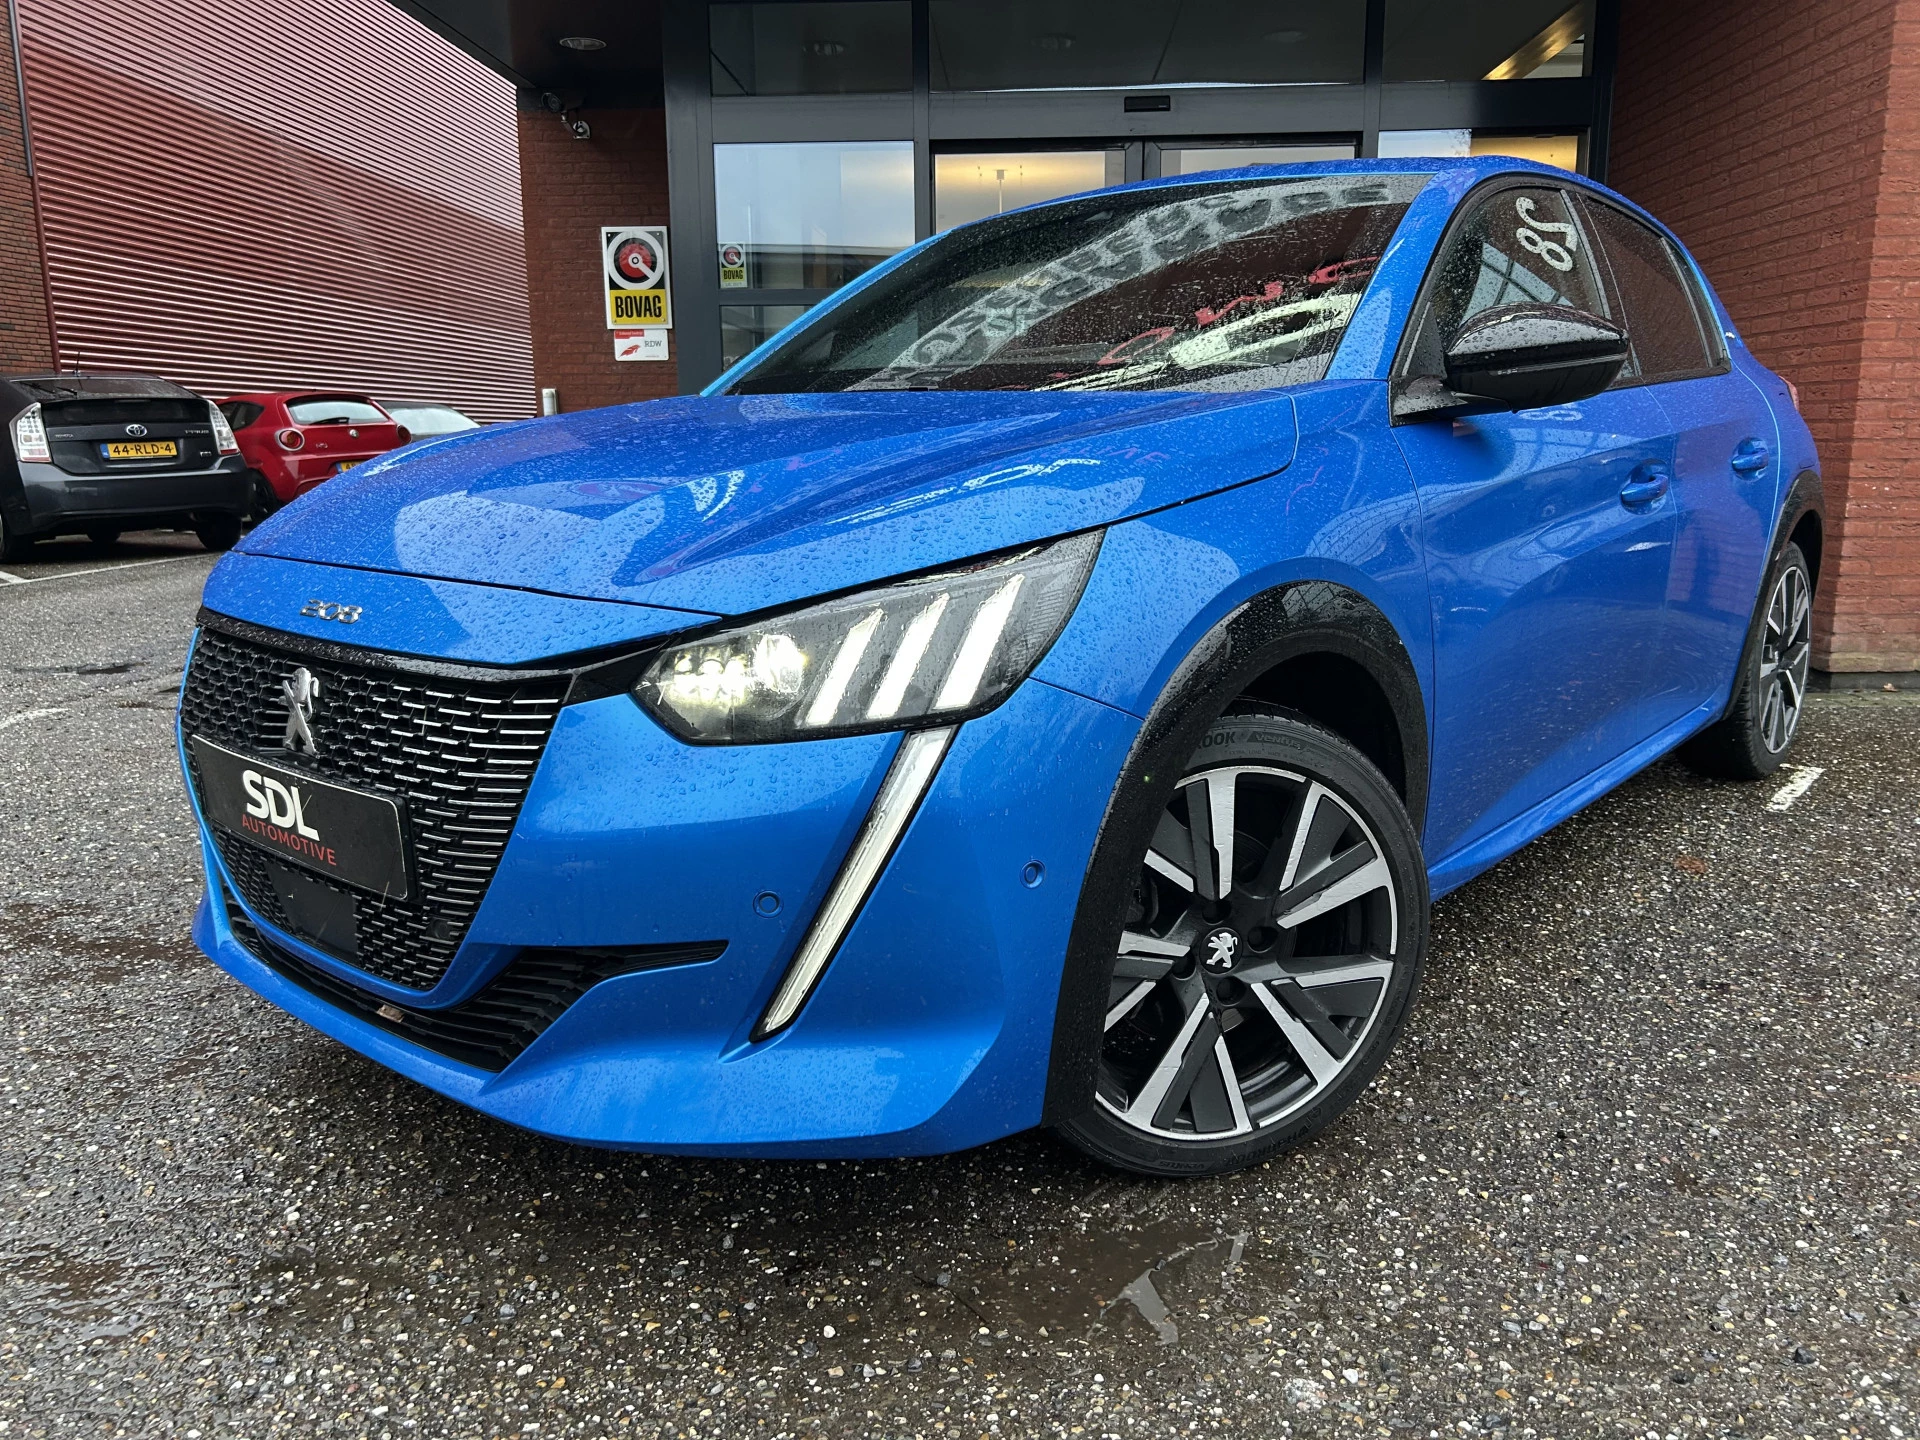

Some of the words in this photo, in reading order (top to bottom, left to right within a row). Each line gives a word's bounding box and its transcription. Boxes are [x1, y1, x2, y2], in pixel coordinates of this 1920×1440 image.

[723, 269, 744, 280] BOVAG
[615, 295, 662, 319] BOVAG
[644, 340, 662, 348] RDW
[113, 443, 172, 456] 44-RLD-4
[299, 598, 363, 624] 208
[242, 769, 321, 841] SDL
[241, 814, 338, 867] AUTOMOTIVE
